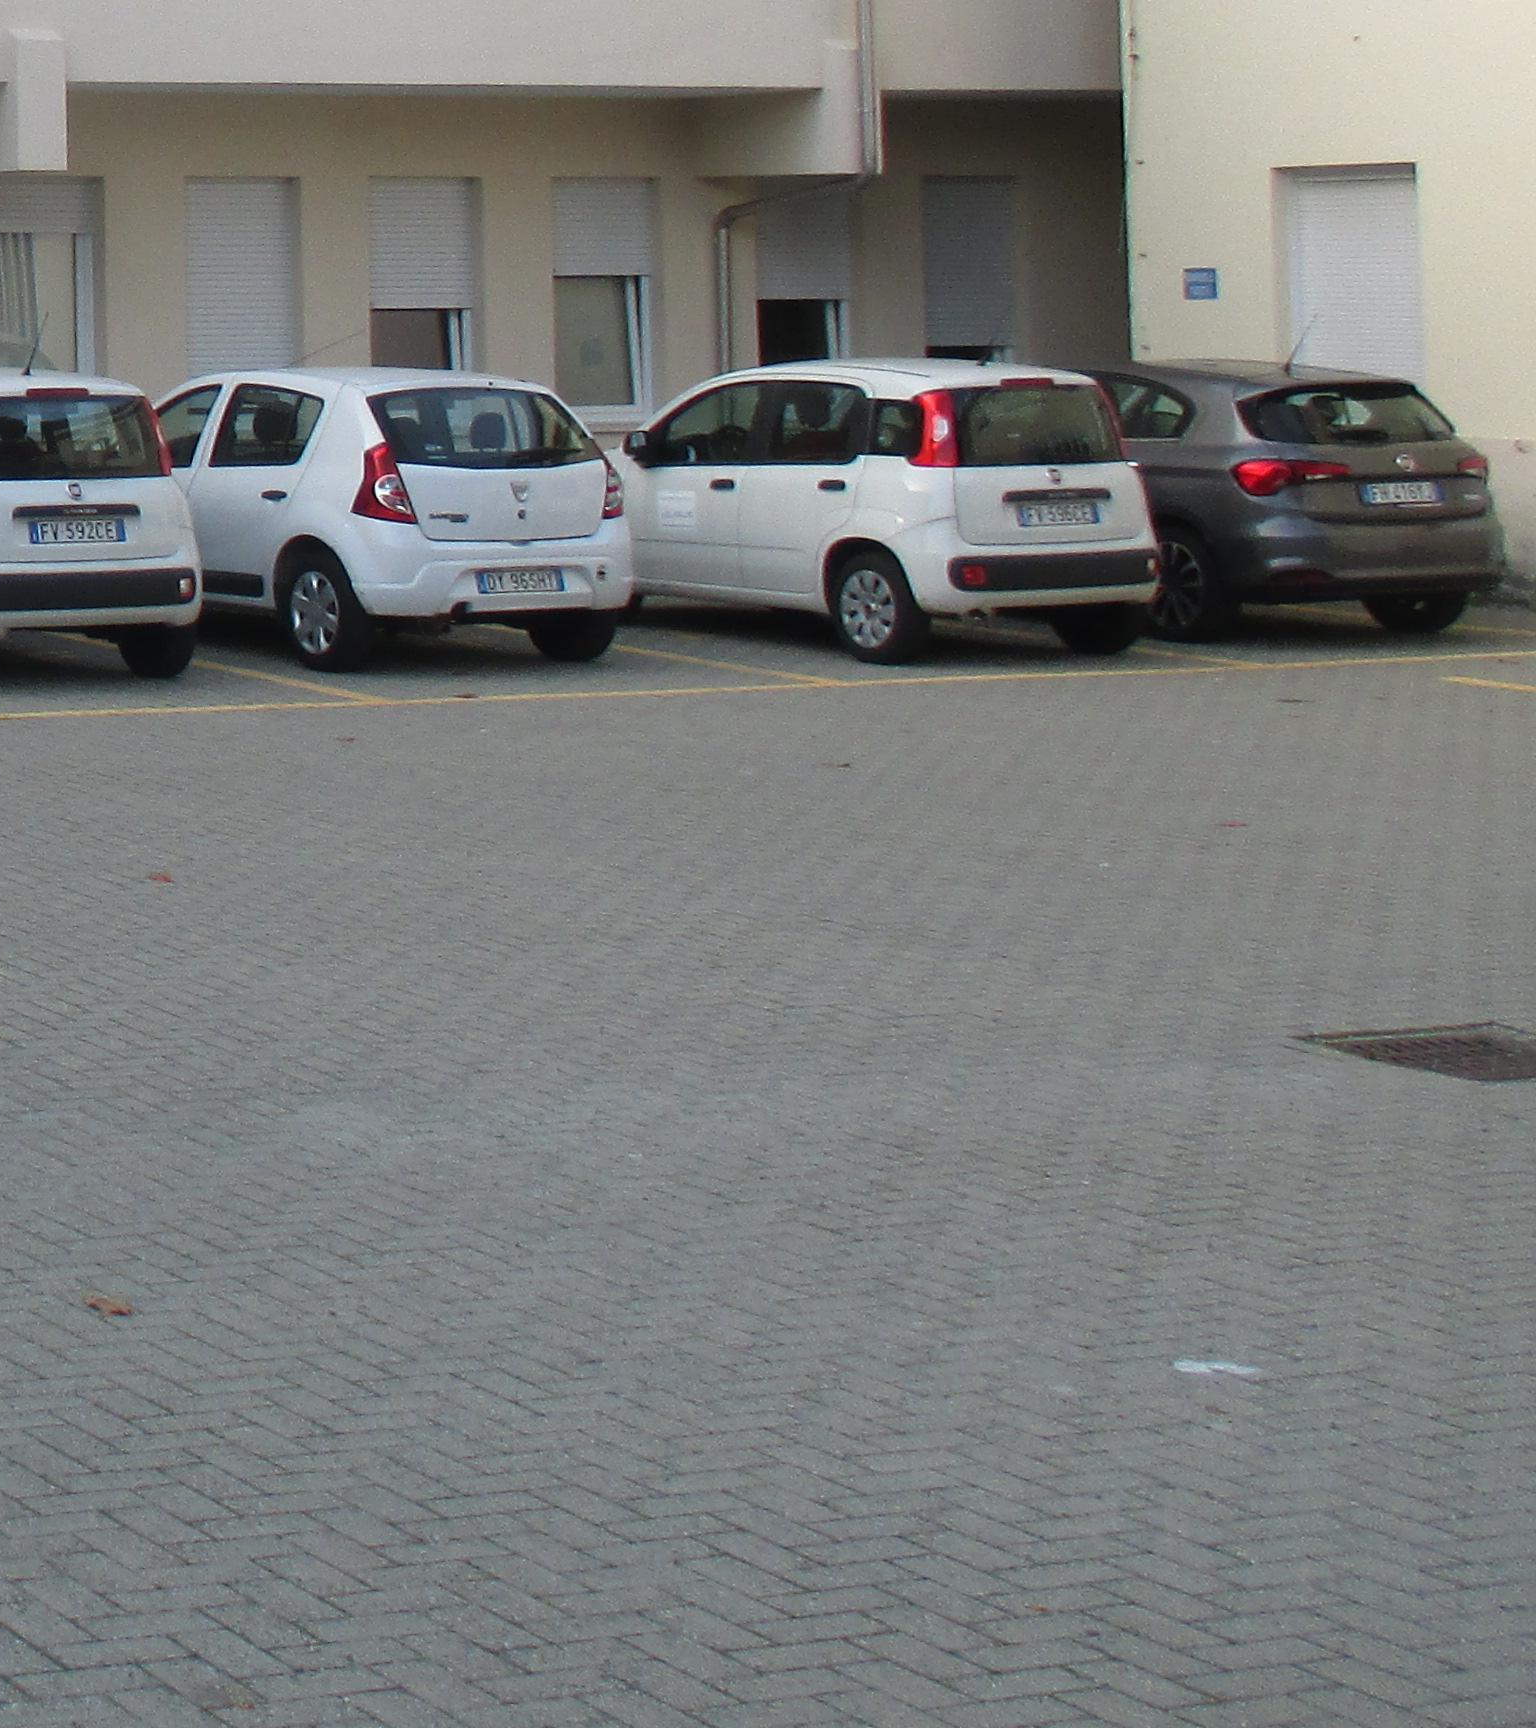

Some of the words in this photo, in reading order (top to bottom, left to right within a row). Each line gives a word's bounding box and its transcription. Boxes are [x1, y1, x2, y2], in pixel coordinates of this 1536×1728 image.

[39, 522, 59, 541] FV
[65, 520, 115, 540] 592CE
[487, 573, 506, 591] DY
